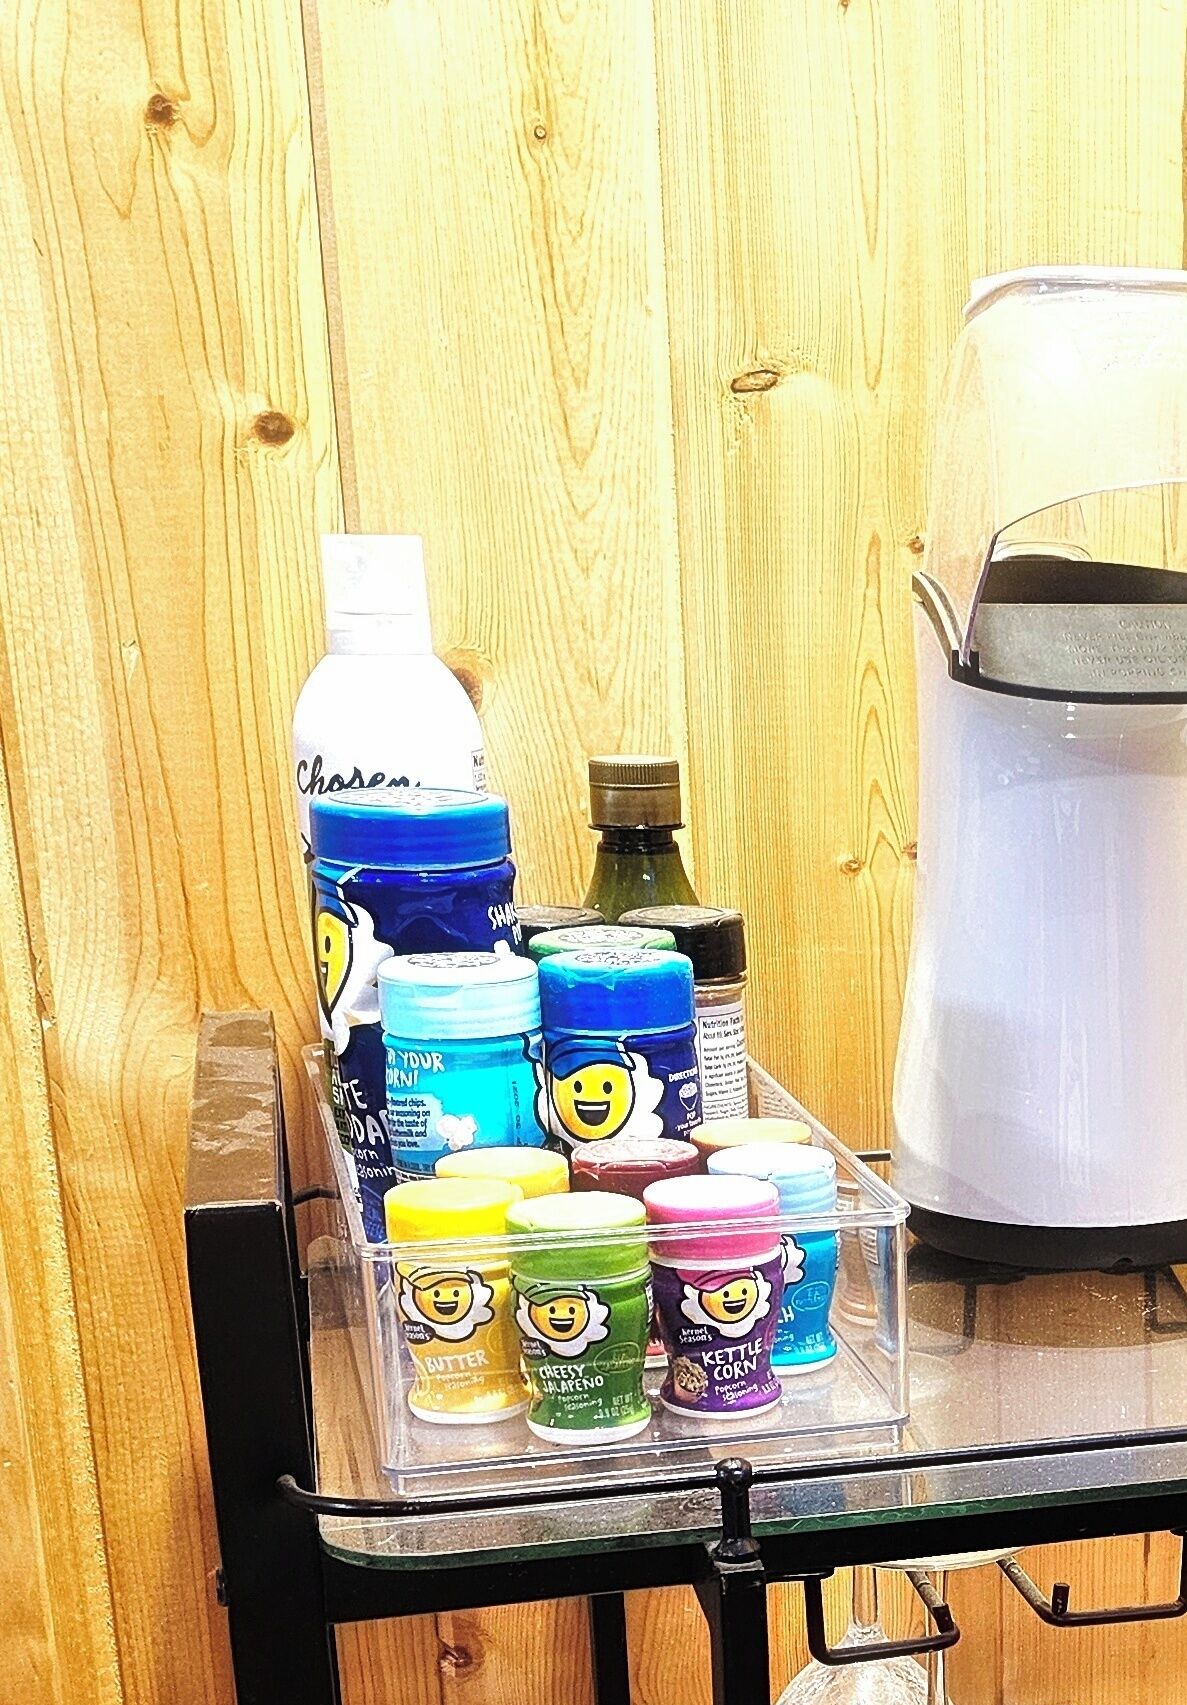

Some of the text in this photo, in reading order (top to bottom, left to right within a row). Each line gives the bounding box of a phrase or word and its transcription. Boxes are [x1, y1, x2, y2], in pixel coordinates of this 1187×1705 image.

[702, 1019, 729, 1030] Nutrition
[397, 1050, 446, 1074] YOUR
[424, 1349, 490, 1374] BUTTER
[701, 1337, 763, 1367] KETTLE
[539, 1363, 586, 1380] CHEESY
[713, 1355, 758, 1381] CORN
